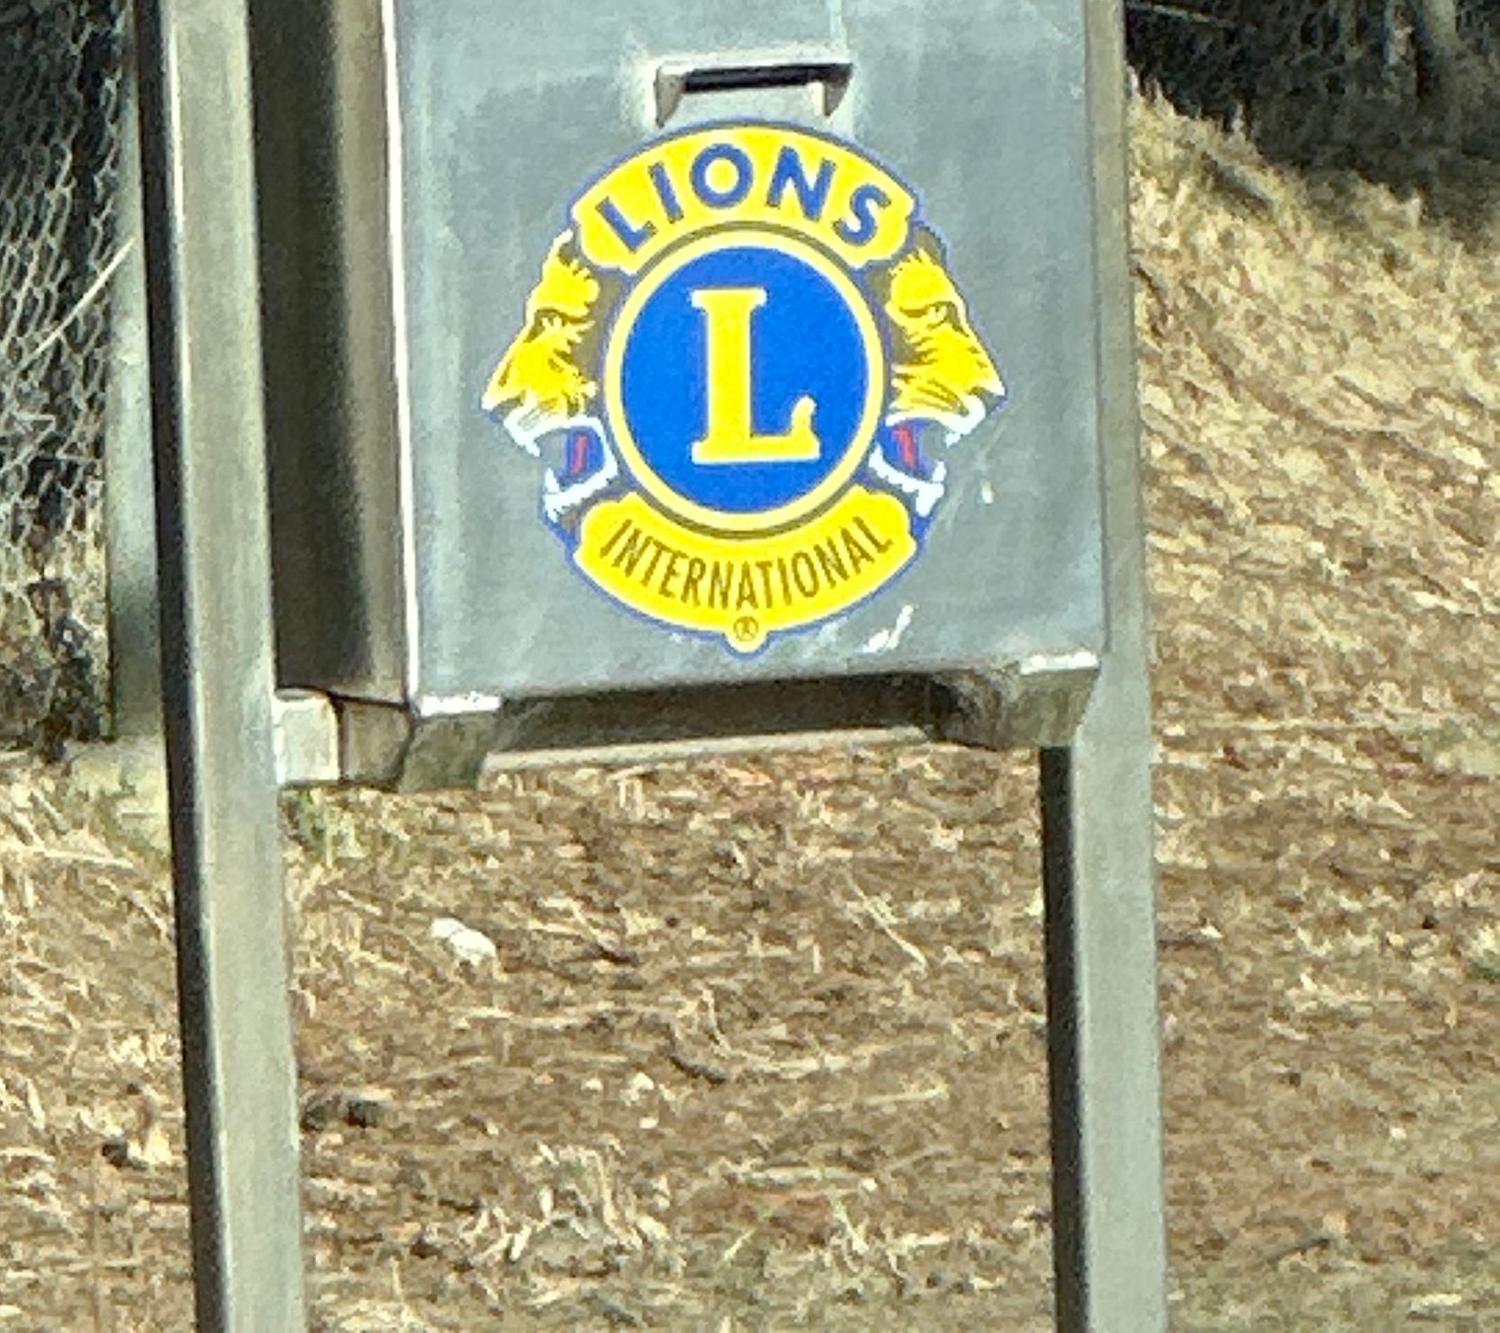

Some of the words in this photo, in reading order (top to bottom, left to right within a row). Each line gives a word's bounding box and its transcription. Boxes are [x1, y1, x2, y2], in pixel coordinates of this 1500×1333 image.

[595, 143, 891, 251] LIONS
[690, 287, 821, 466] L
[599, 515, 893, 612] INTERNATIONAL
